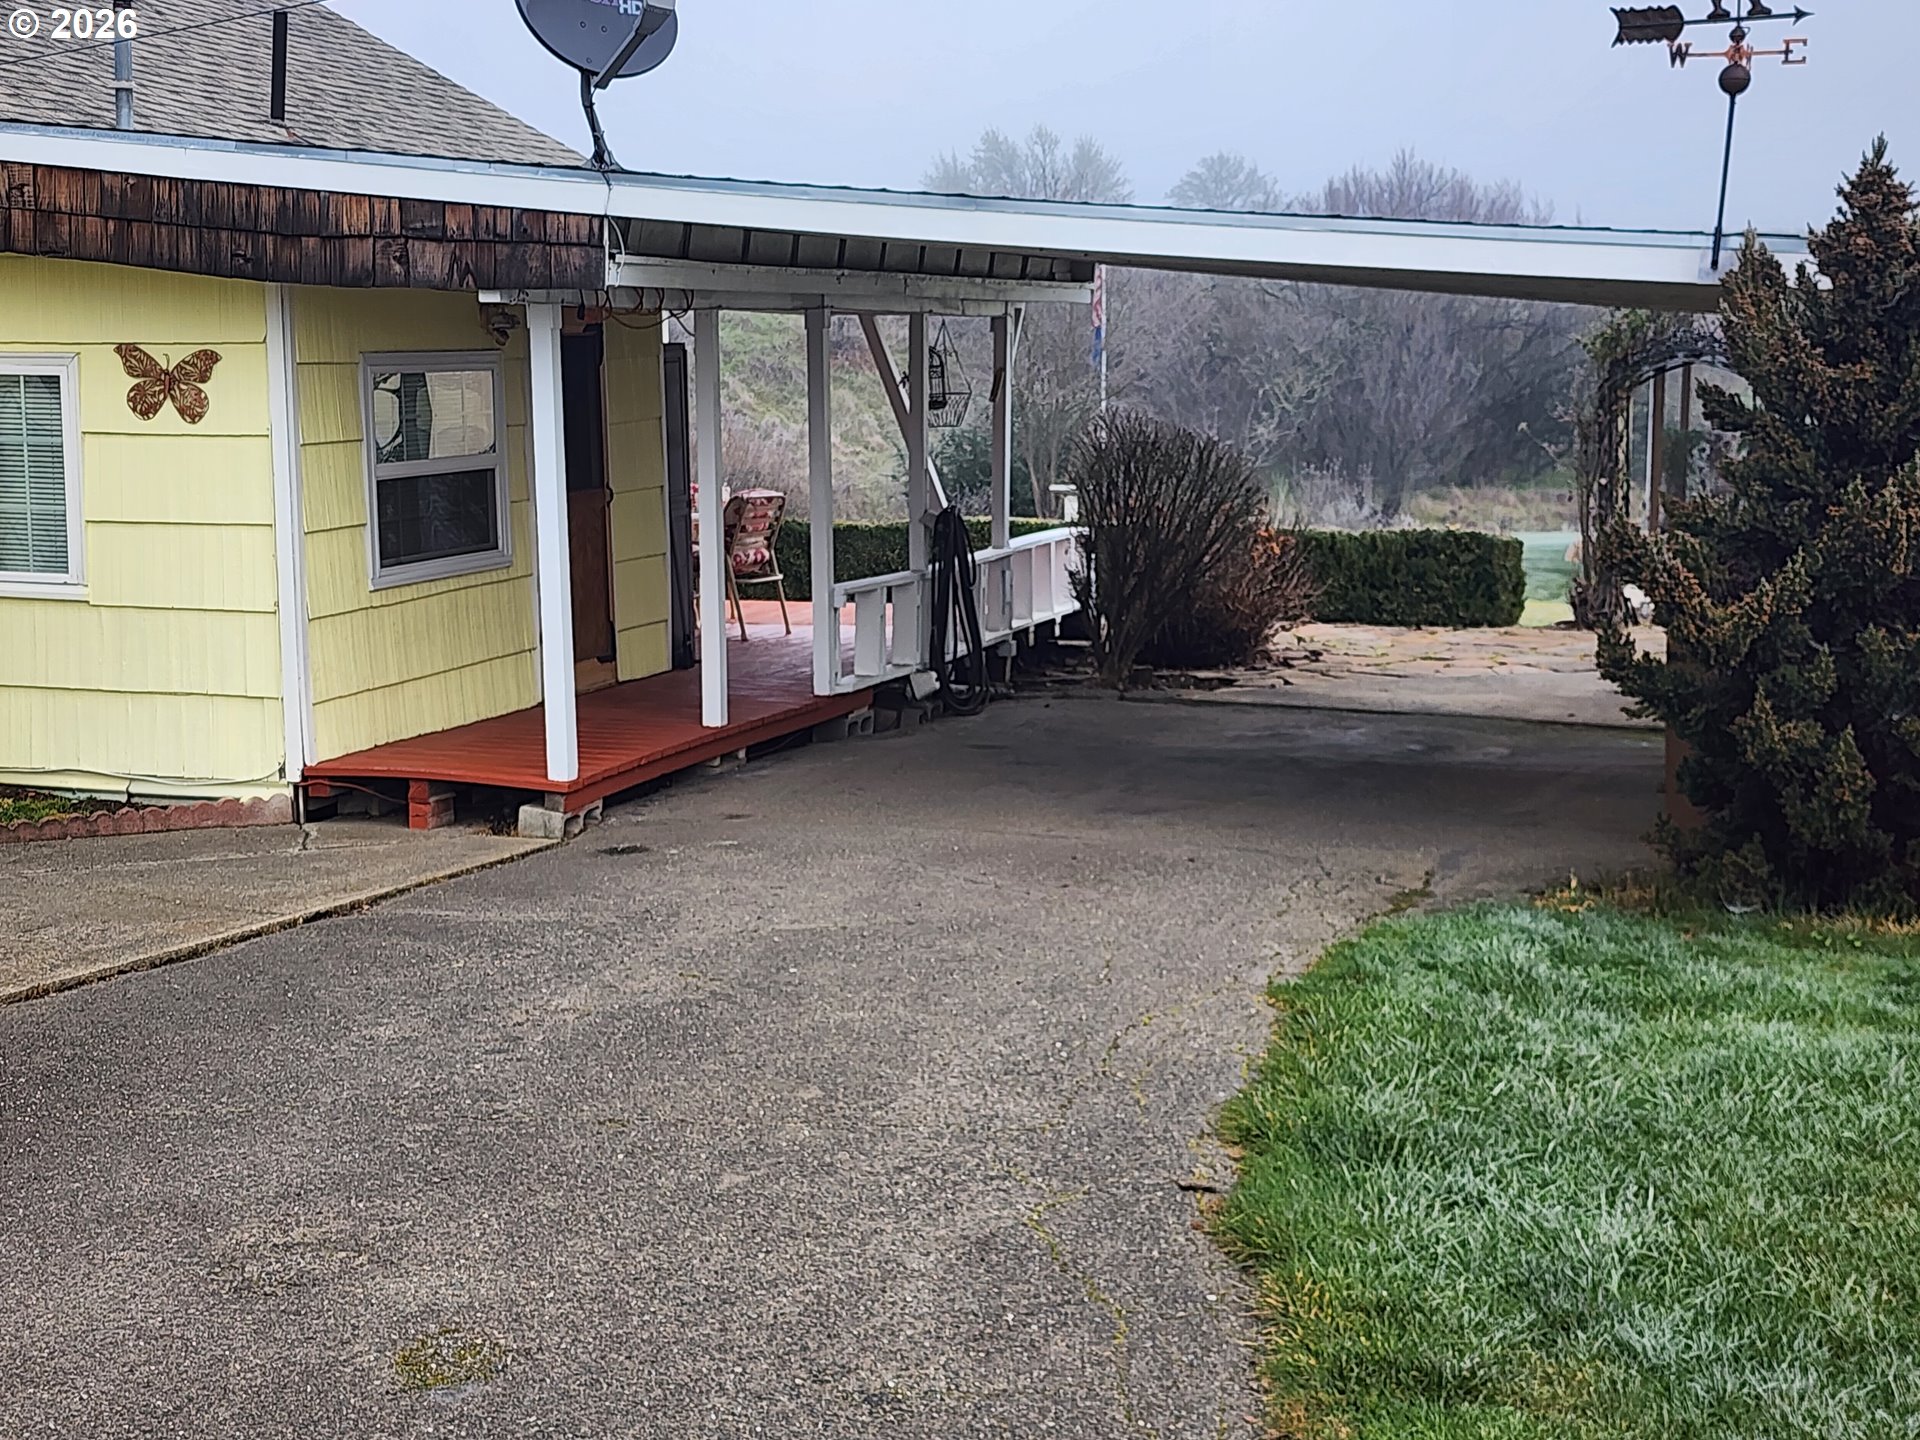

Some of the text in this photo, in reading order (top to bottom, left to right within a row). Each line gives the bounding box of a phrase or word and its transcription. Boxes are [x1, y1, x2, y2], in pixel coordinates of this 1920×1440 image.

[619, 0, 643, 15] HD
[1667, 43, 1692, 68] W
[1782, 38, 1808, 65] E
